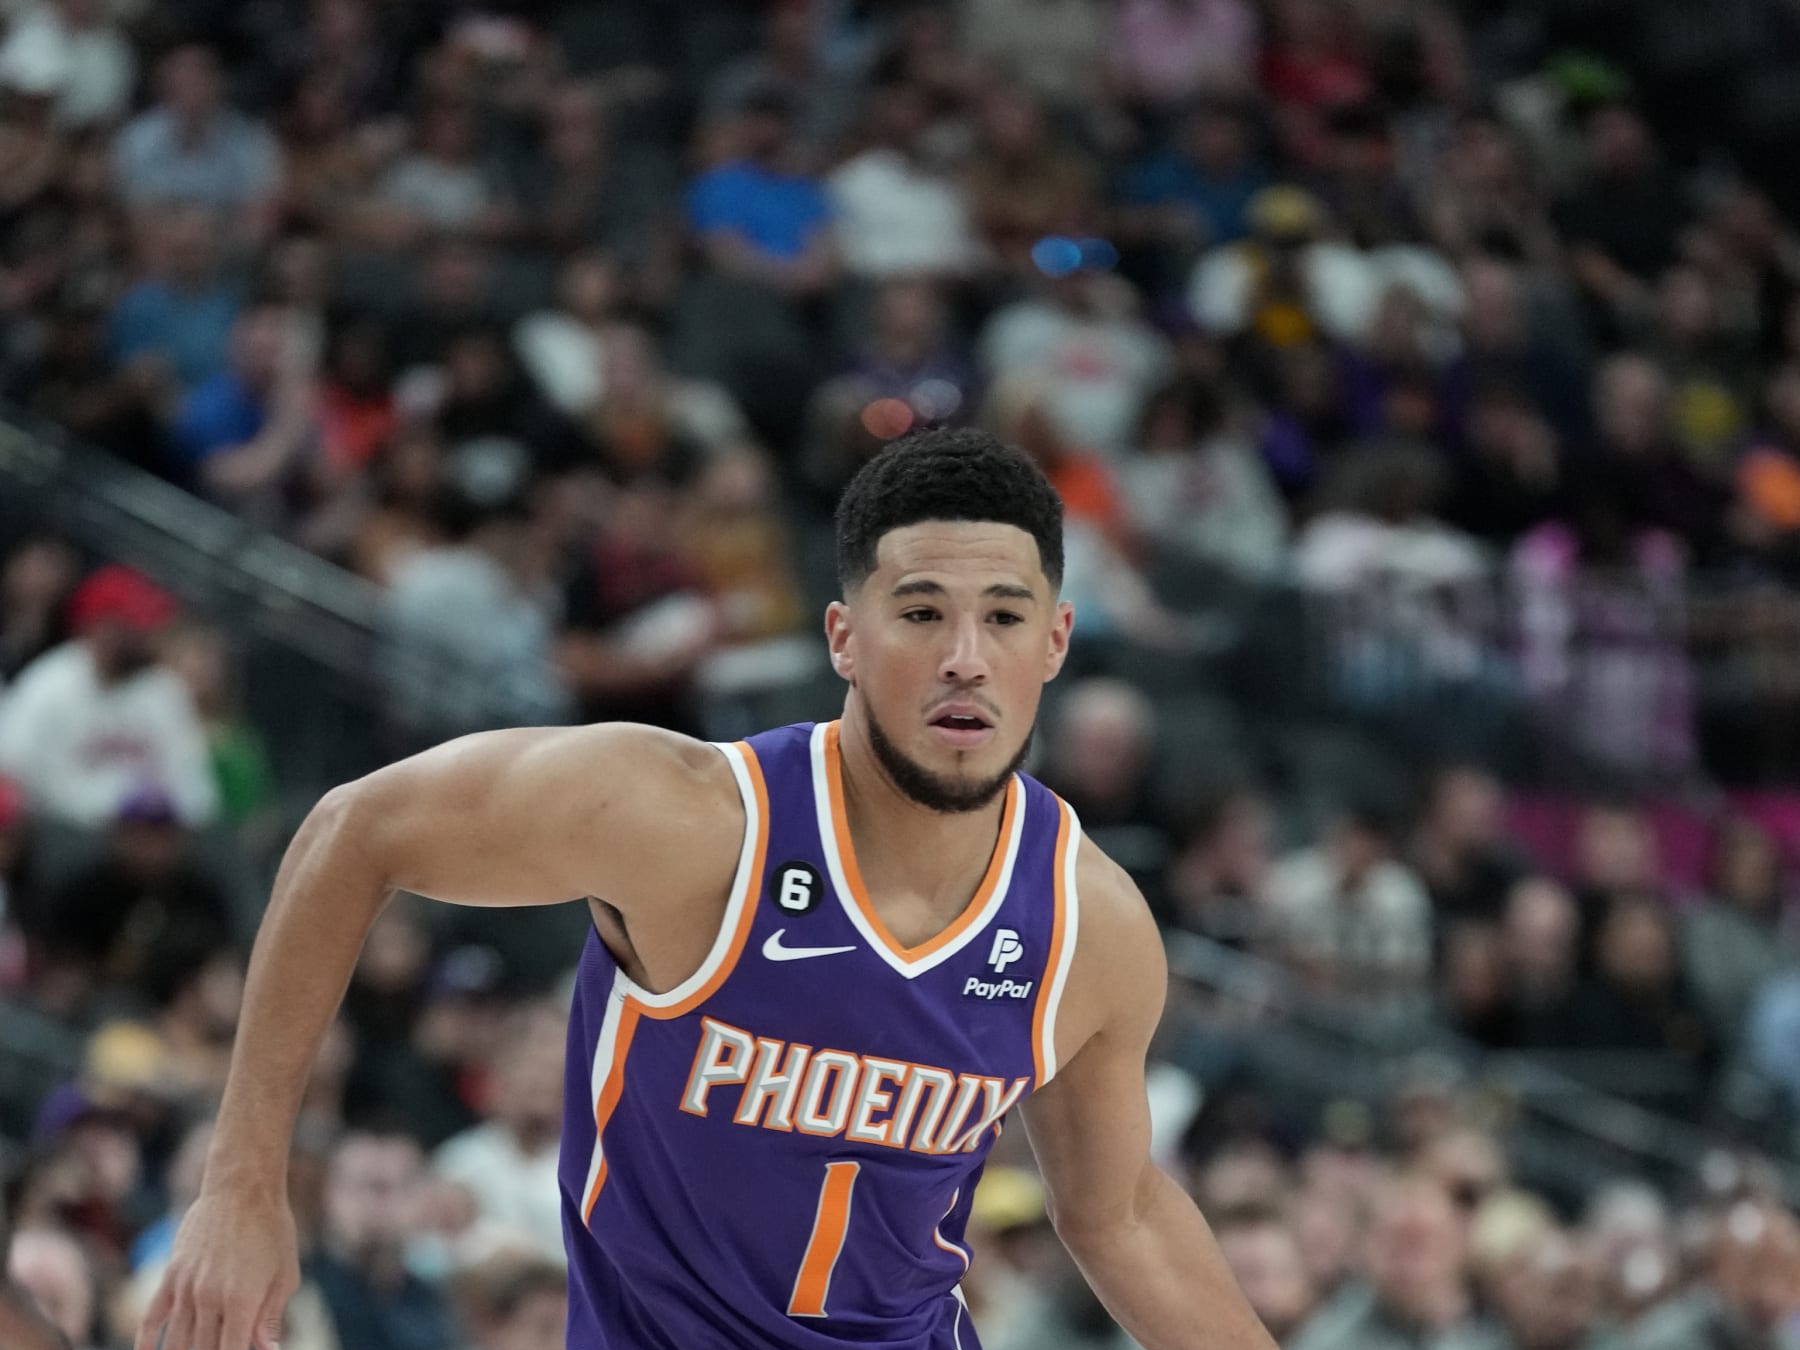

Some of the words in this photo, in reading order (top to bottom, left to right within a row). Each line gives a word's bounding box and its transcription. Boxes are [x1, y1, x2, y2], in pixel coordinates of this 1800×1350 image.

[780, 869, 812, 910] 6
[963, 977, 1033, 999] PayPal
[679, 1015, 1031, 1155] PHOENIX
[786, 1161, 861, 1318] 1
